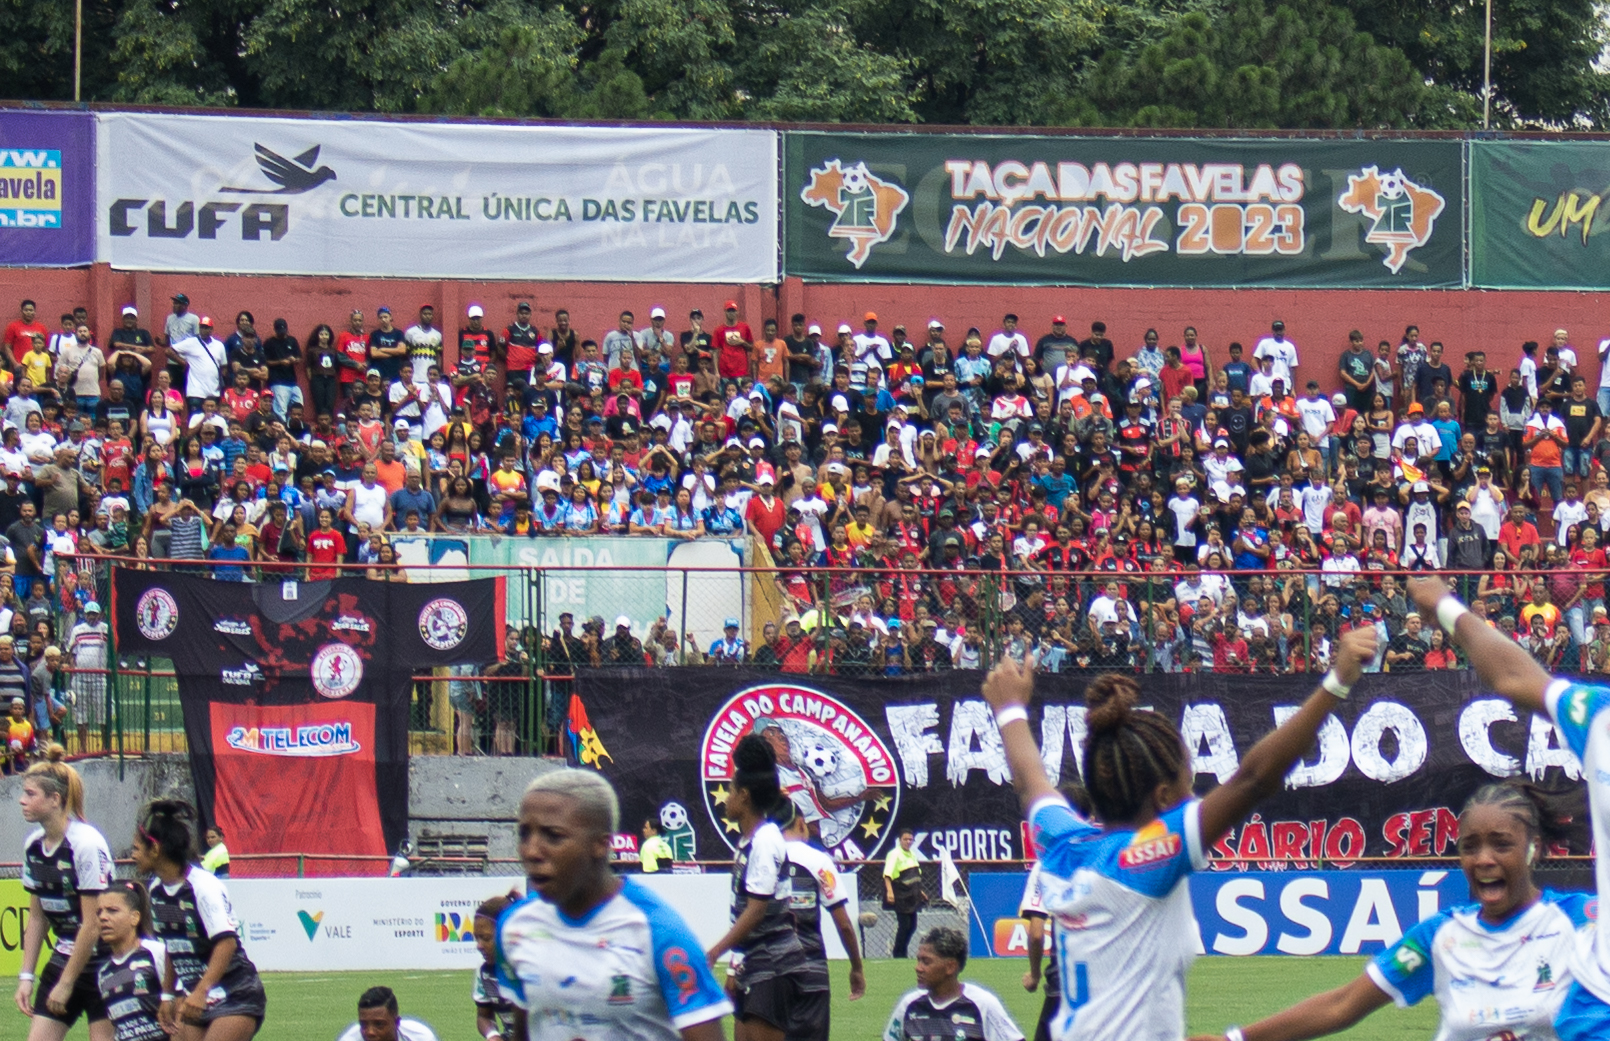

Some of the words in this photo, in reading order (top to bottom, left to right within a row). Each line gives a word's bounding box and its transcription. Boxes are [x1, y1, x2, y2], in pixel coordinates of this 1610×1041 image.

[946, 160, 1051, 207] TAÇA
[1057, 163, 1140, 201] DAS
[1139, 163, 1304, 202] FAVELAS
[109, 199, 288, 241] CUFA
[340, 193, 470, 220] CENTRAL
[482, 192, 573, 222] ÚNICA
[582, 199, 636, 222] DAS
[642, 200, 759, 224] FAVELAS
[1526, 190, 1598, 245] UM
[945, 201, 1169, 262] NACIONAL
[518, 541, 615, 567] SAÍDA
[550, 578, 587, 604] DE
[260, 722, 351, 750] TELECOM
[708, 710, 749, 777] FAVELA
[743, 695, 774, 720] DO
[779, 693, 892, 783] CAMPANÁRIO
[373, 916, 413, 926] MINISTÉRIO
[415, 917, 425, 926] DO
[1197, 871, 1450, 956] SSAÍ
[325, 925, 352, 939] VALE
[394, 930, 425, 939] ESPORTE
